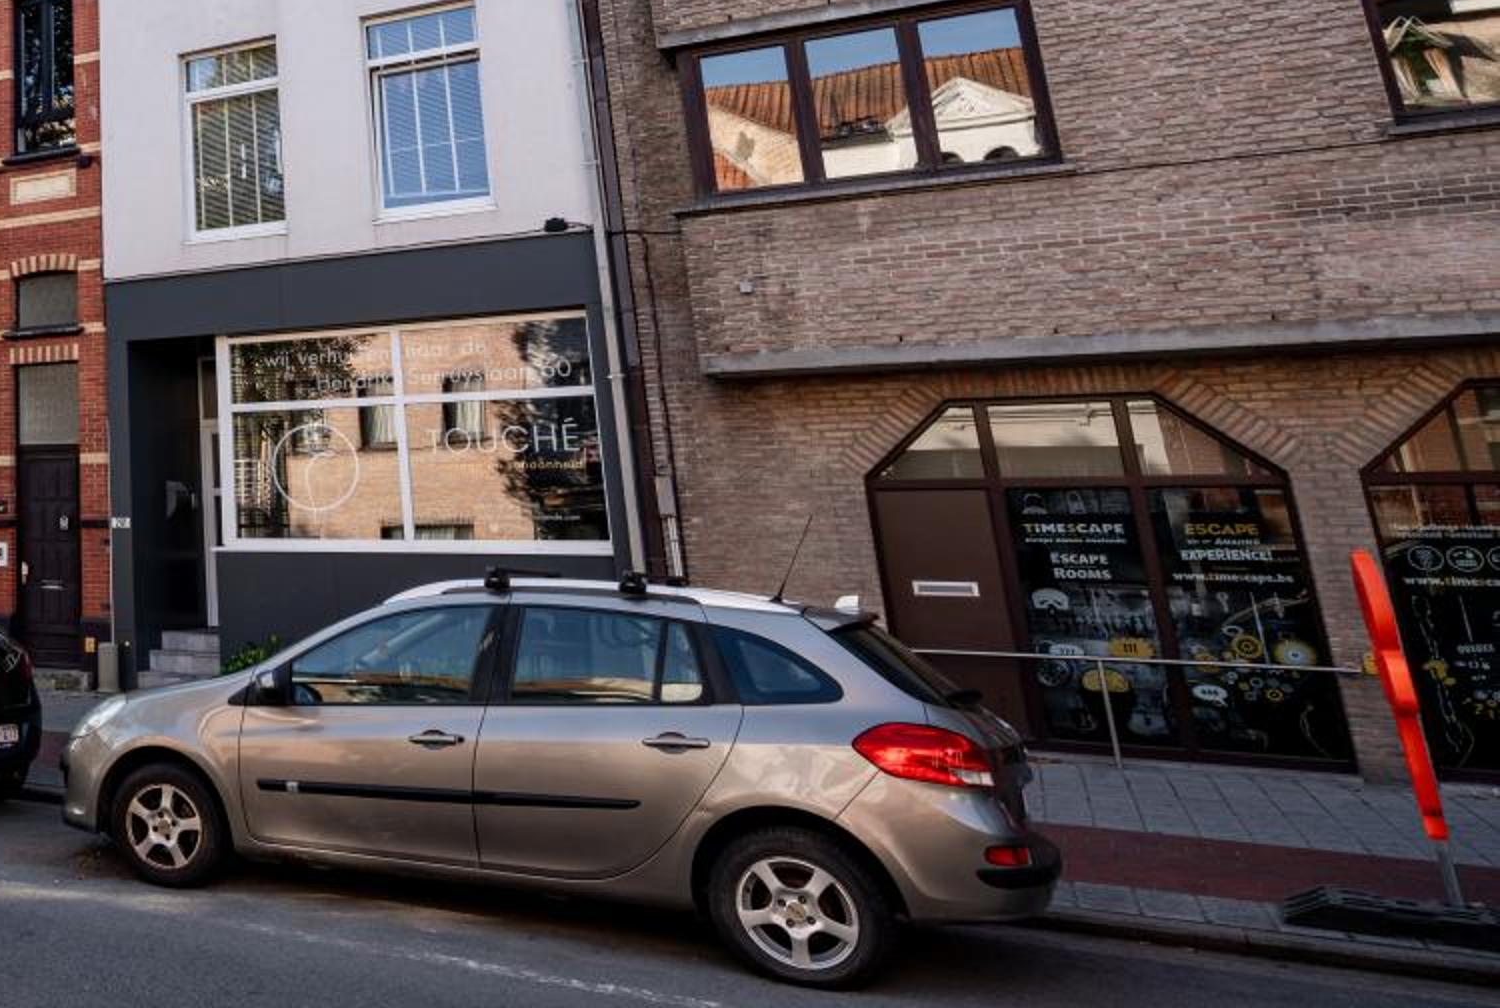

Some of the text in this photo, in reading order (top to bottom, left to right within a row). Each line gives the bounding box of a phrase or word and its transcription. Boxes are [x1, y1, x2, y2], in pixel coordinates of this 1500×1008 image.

[263, 351, 290, 371] wij
[297, 345, 390, 366] verhuen
[427, 417, 581, 454] TOUCHÉ
[1022, 523, 1125, 534] TIMESCAPE
